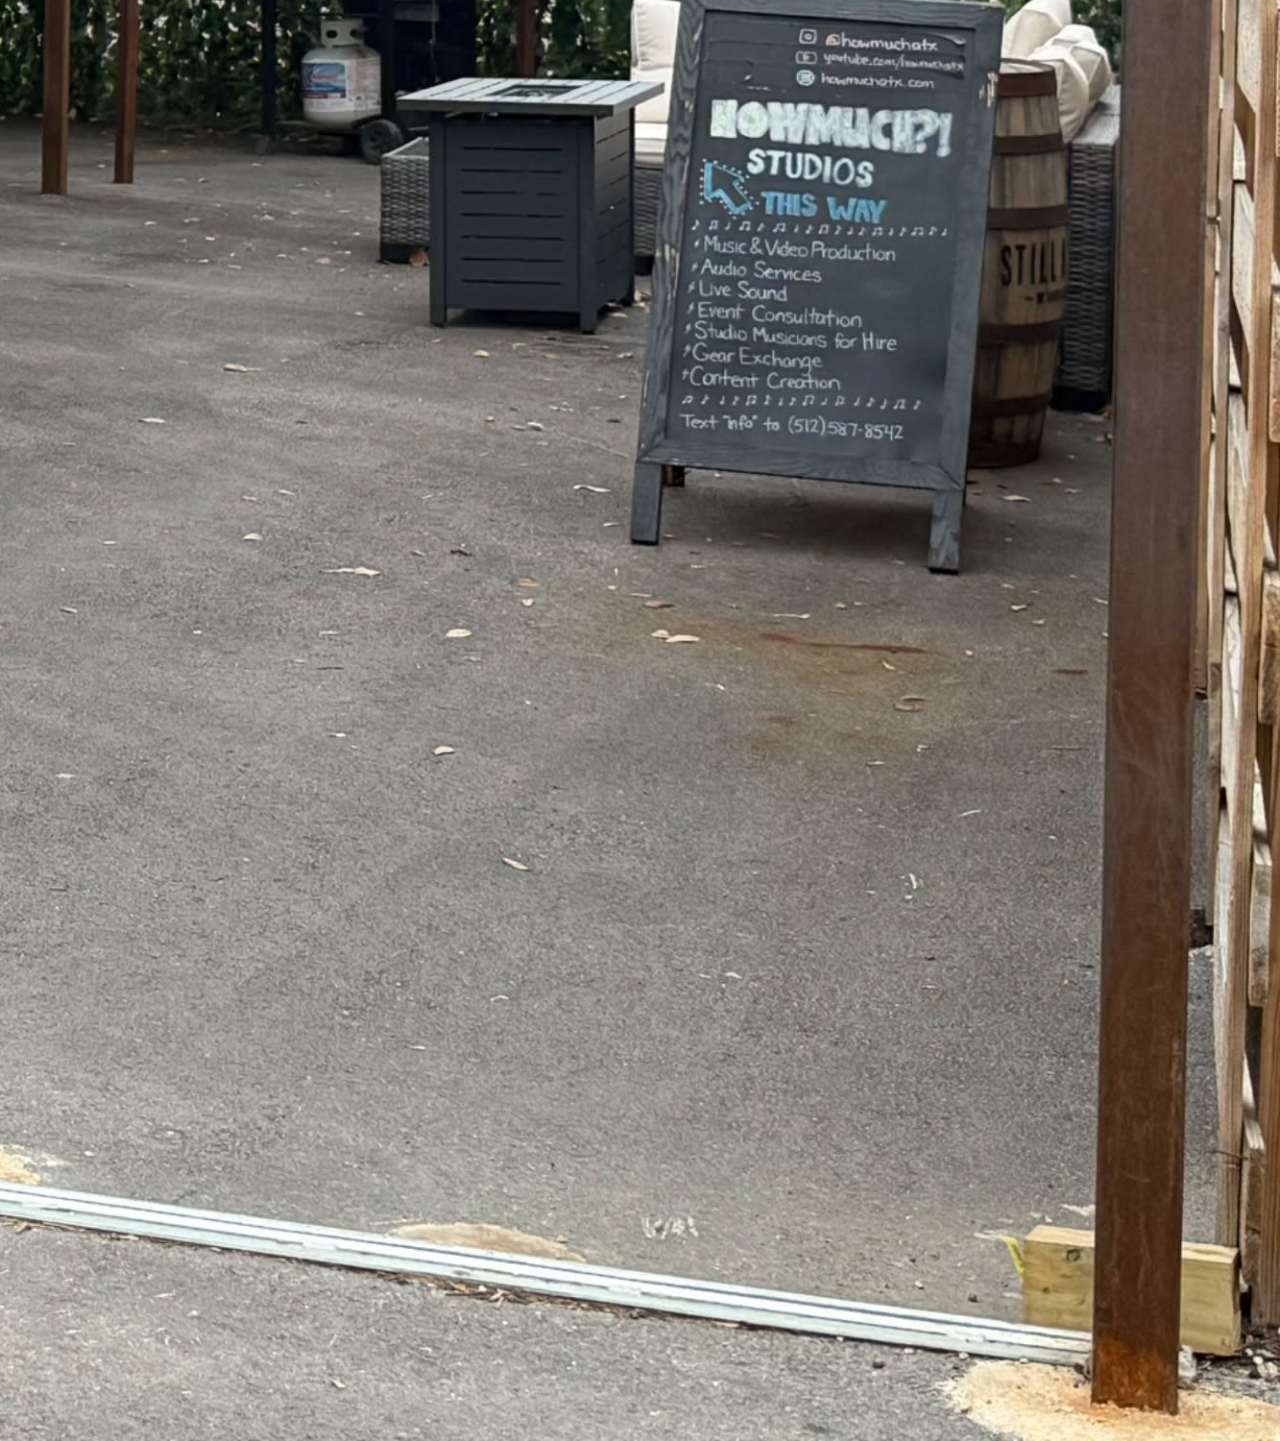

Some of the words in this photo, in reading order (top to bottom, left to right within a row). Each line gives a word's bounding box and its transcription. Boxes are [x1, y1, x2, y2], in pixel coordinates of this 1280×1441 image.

[825, 32, 938, 52] @howmuchatx
[710, 99, 953, 158] HOWMUCH?!
[747, 148, 874, 187] STUDIOS
[761, 191, 817, 217] THIS
[826, 196, 888, 224] WAY
[704, 235, 747, 255] Music
[765, 239, 808, 257] Video
[811, 241, 896, 261] Production
[701, 258, 747, 277] Audio
[754, 261, 822, 282] Services
[698, 279, 732, 297] Live
[737, 281, 788, 301] Sound
[697, 302, 744, 320] Event
[752, 305, 862, 328] Consultation
[695, 320, 748, 340] Studio
[753, 327, 827, 348] Musicians
[835, 332, 857, 349] for
[862, 332, 898, 352] Hire
[692, 342, 736, 362] Gear
[739, 346, 823, 376] Exchange
[690, 366, 759, 388] Content
[767, 372, 841, 390] Creation
[680, 413, 719, 429] Text
[763, 416, 780, 431] to
